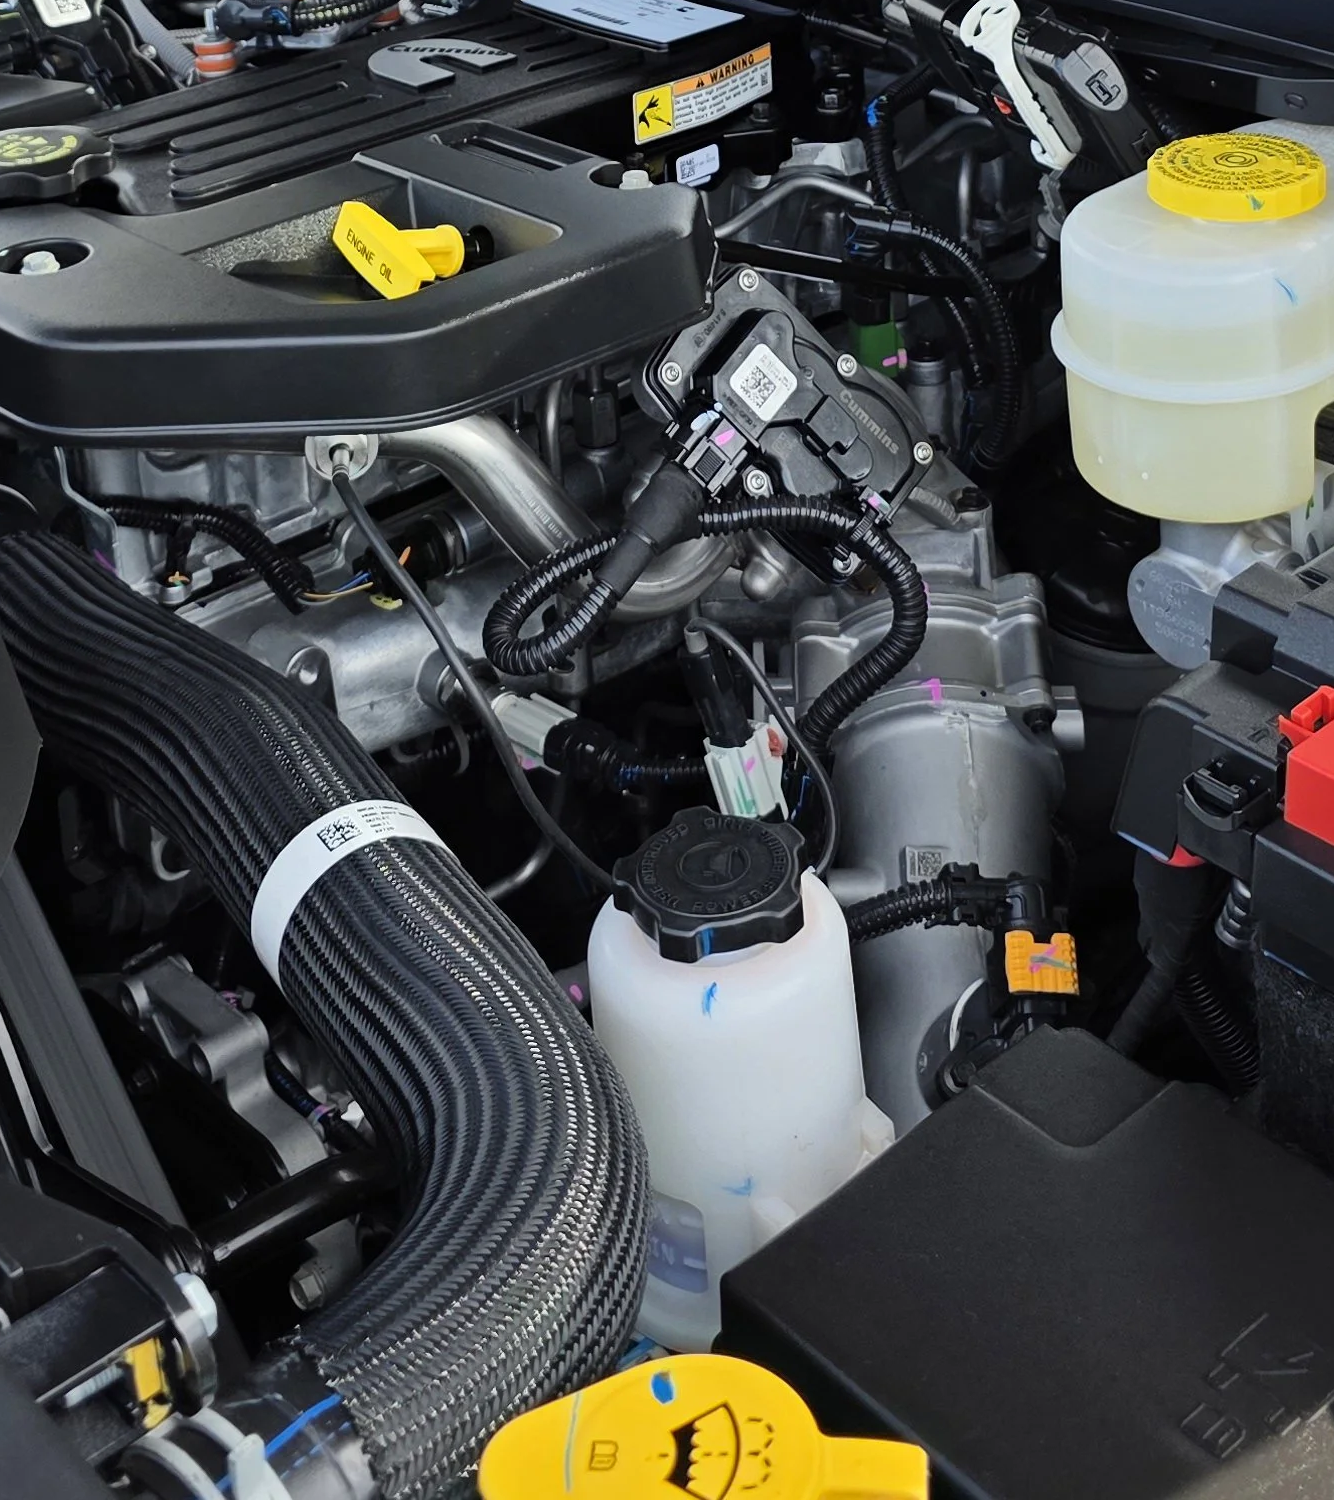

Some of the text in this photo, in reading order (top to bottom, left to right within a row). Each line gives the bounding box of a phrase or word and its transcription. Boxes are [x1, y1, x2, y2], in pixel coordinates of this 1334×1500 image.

[387, 44, 508, 56] Cummins
[709, 54, 754, 83] WARNING
[347, 228, 393, 285] ENGINE OIL
[840, 389, 899, 454] Cummins
[641, 823, 690, 886] APPROVED
[691, 887, 765, 915] POWER
